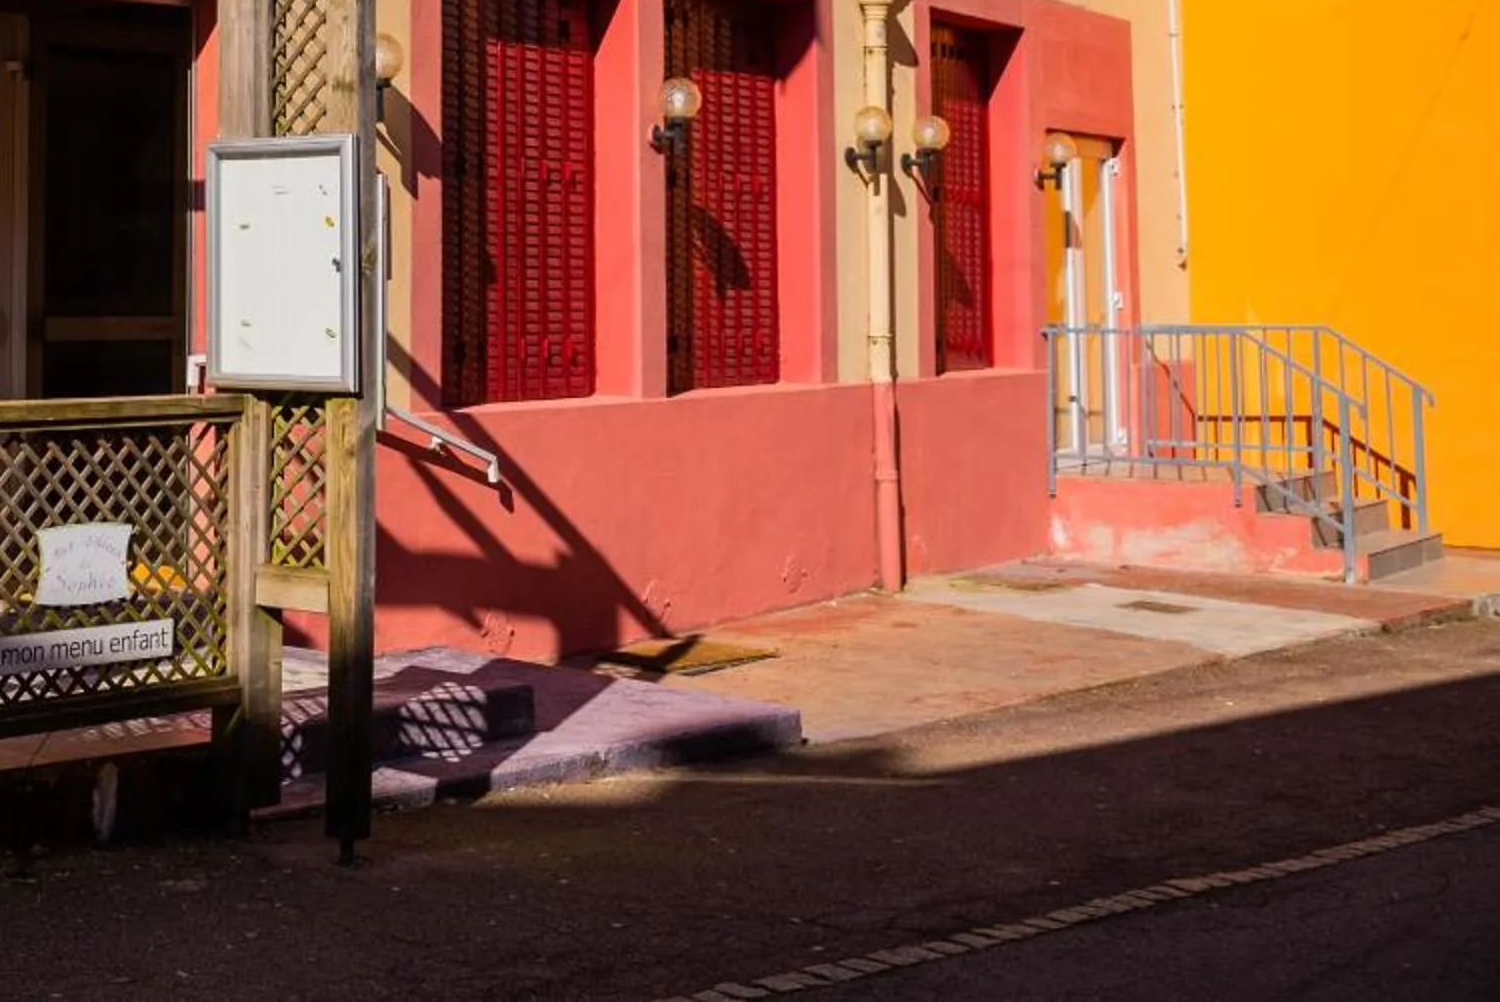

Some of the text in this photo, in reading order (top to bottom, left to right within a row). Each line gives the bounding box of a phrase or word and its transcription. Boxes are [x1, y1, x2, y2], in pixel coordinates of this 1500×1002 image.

[1, 627, 169, 666] mon menu enfant
